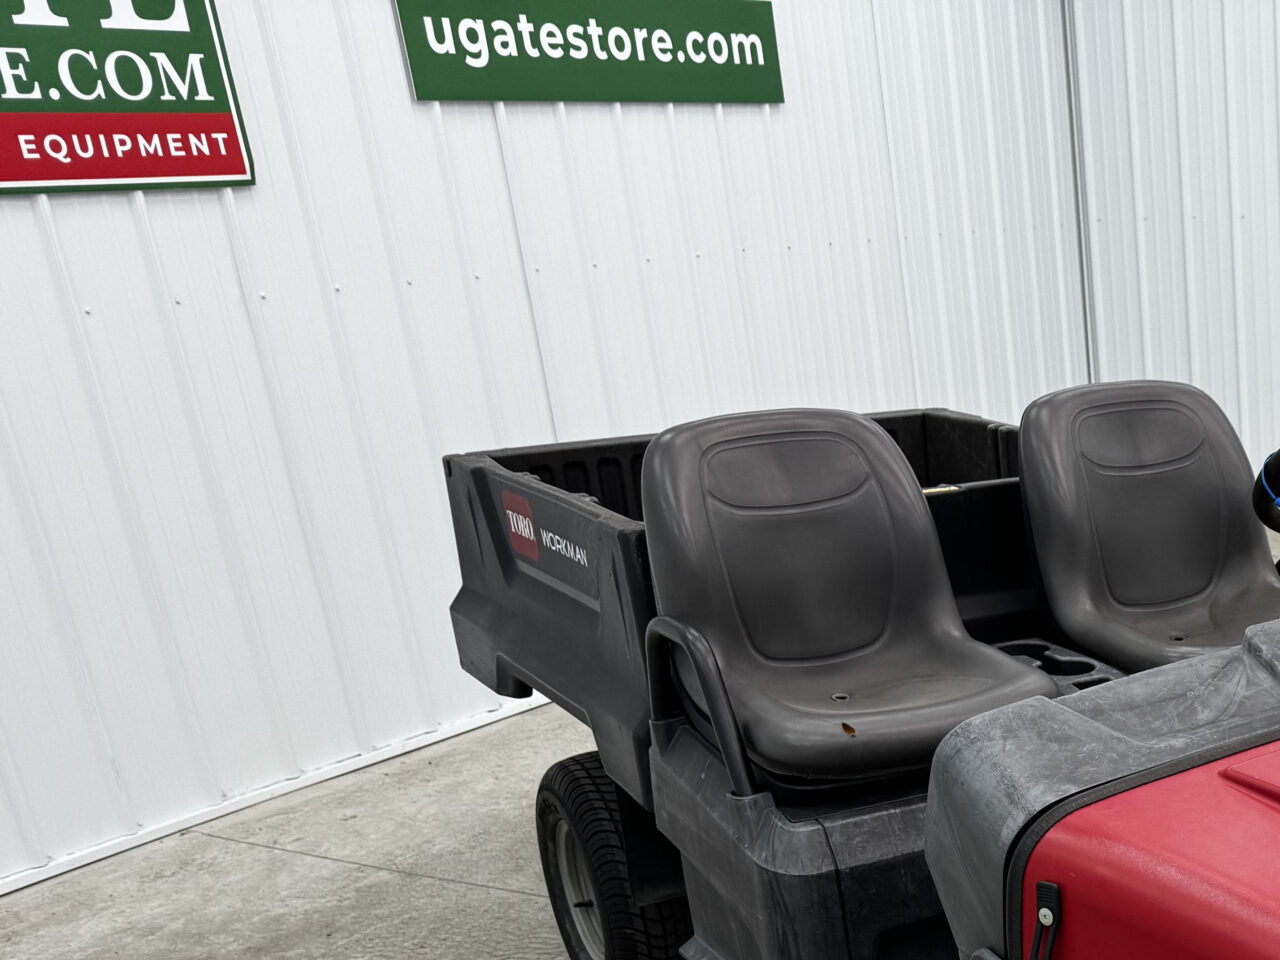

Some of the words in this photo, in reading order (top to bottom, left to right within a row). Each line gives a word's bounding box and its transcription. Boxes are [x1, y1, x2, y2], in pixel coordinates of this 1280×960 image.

[423, 14, 765, 67] ugatestore.com
[17, 133, 228, 163] EQUIPMENT
[506, 509, 535, 541] TORO
[540, 527, 588, 568] WORKMAN
